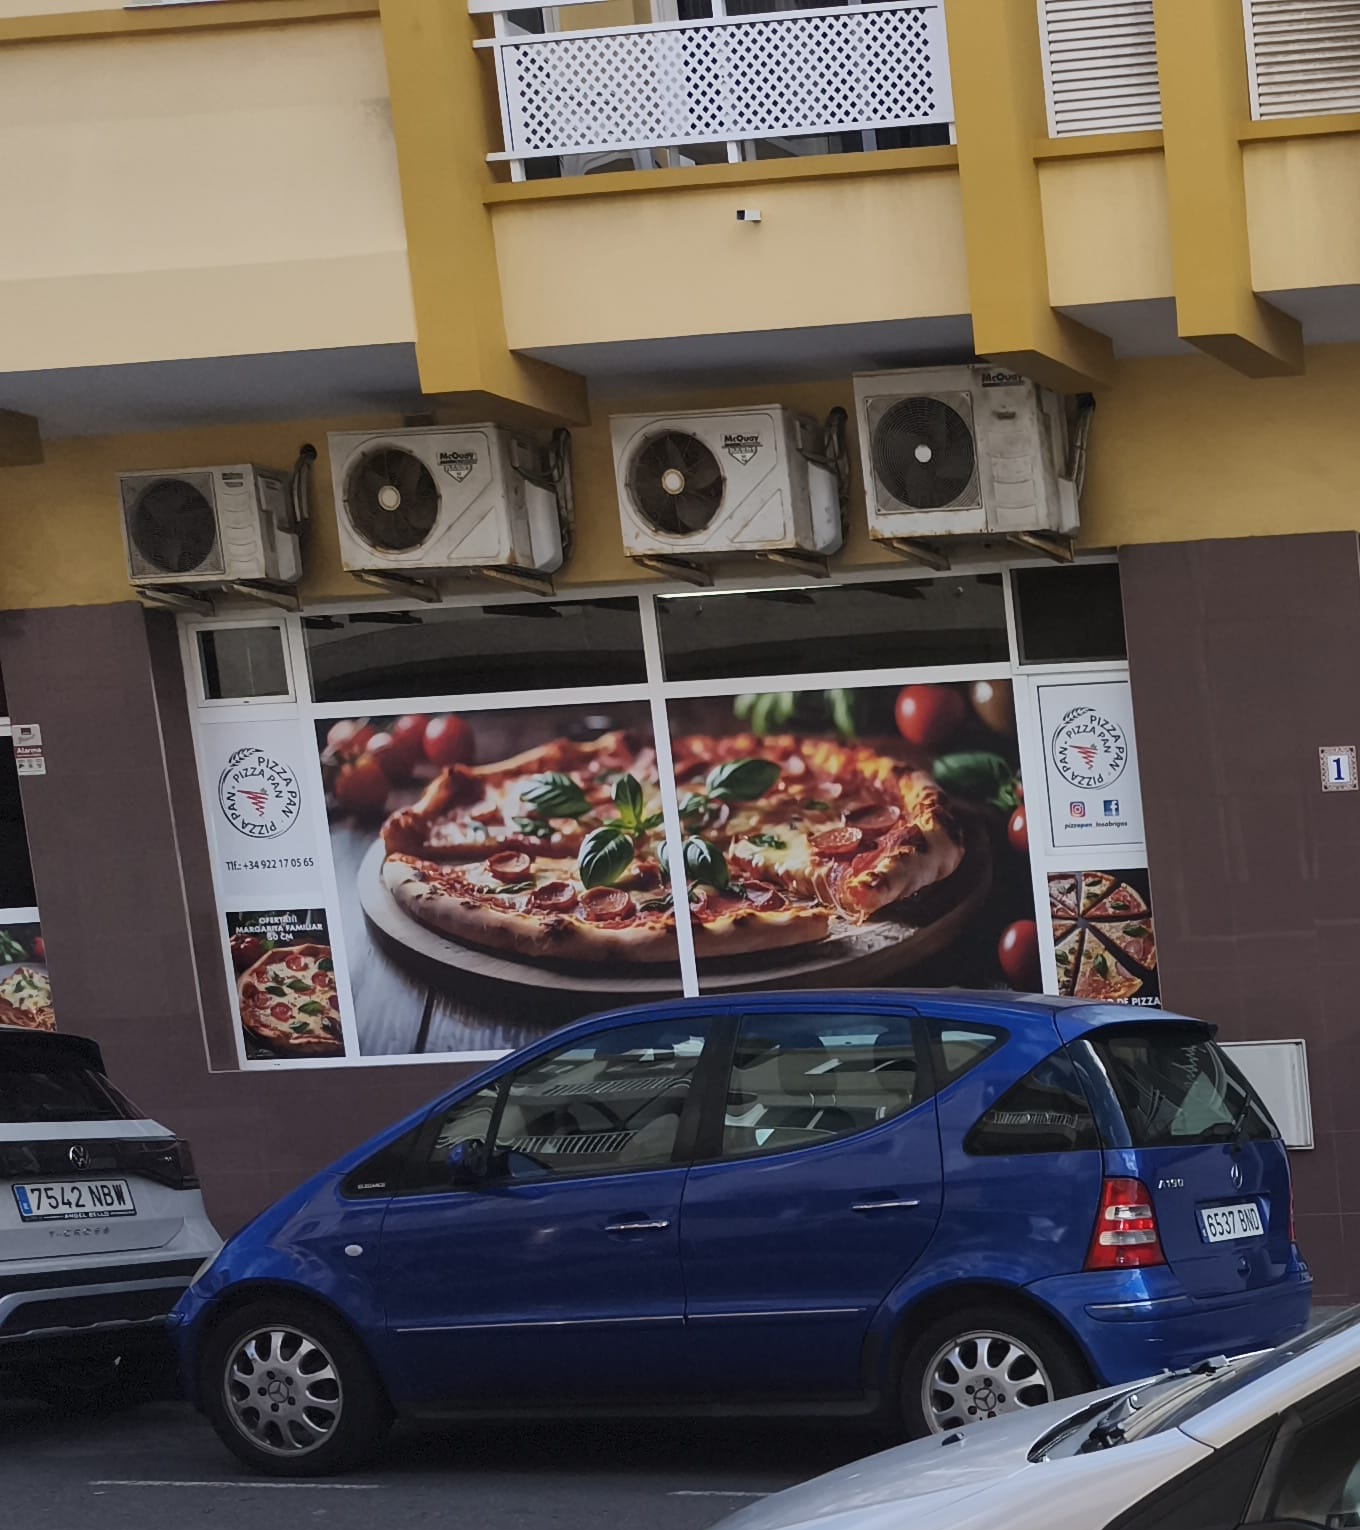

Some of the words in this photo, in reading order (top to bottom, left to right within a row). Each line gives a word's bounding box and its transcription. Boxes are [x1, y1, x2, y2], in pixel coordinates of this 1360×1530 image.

[982, 372, 1023, 383] McQuay
[724, 434, 759, 443] McQuay
[440, 451, 474, 460] McQuay
[1065, 724, 1096, 739] PIZZA
[1097, 731, 1112, 754] PAN
[1090, 714, 1121, 743] PIZZA
[1109, 746, 1124, 772] PAN
[1058, 746, 1071, 773] PAN
[1333, 757, 1345, 781] 1
[232, 766, 265, 783] PIZZA
[266, 774, 283, 799] PAN
[257, 756, 293, 787] PIZZA
[281, 790, 298, 818] PAN
[1071, 773, 1104, 787] PIZZA
[226, 791, 242, 821] PAN
[240, 818, 277, 835] PIZZA
[243, 860, 260, 870] +34
[260, 859, 277, 869] 922
[279, 858, 289, 868] 17
[290, 857, 302, 868] 05
[303, 857, 314, 867] 65
[235, 924, 284, 934] MARGARITA
[285, 923, 323, 932] FAMILIAR
[1131, 997, 1160, 1006] PIZZA
[30, 1186, 86, 1211] 7542
[87, 1184, 127, 1208] NBW
[49, 1227, 110, 1238] T-CROSS
[1206, 1211, 1236, 1238] 6537
[1238, 1208, 1260, 1232] BND
